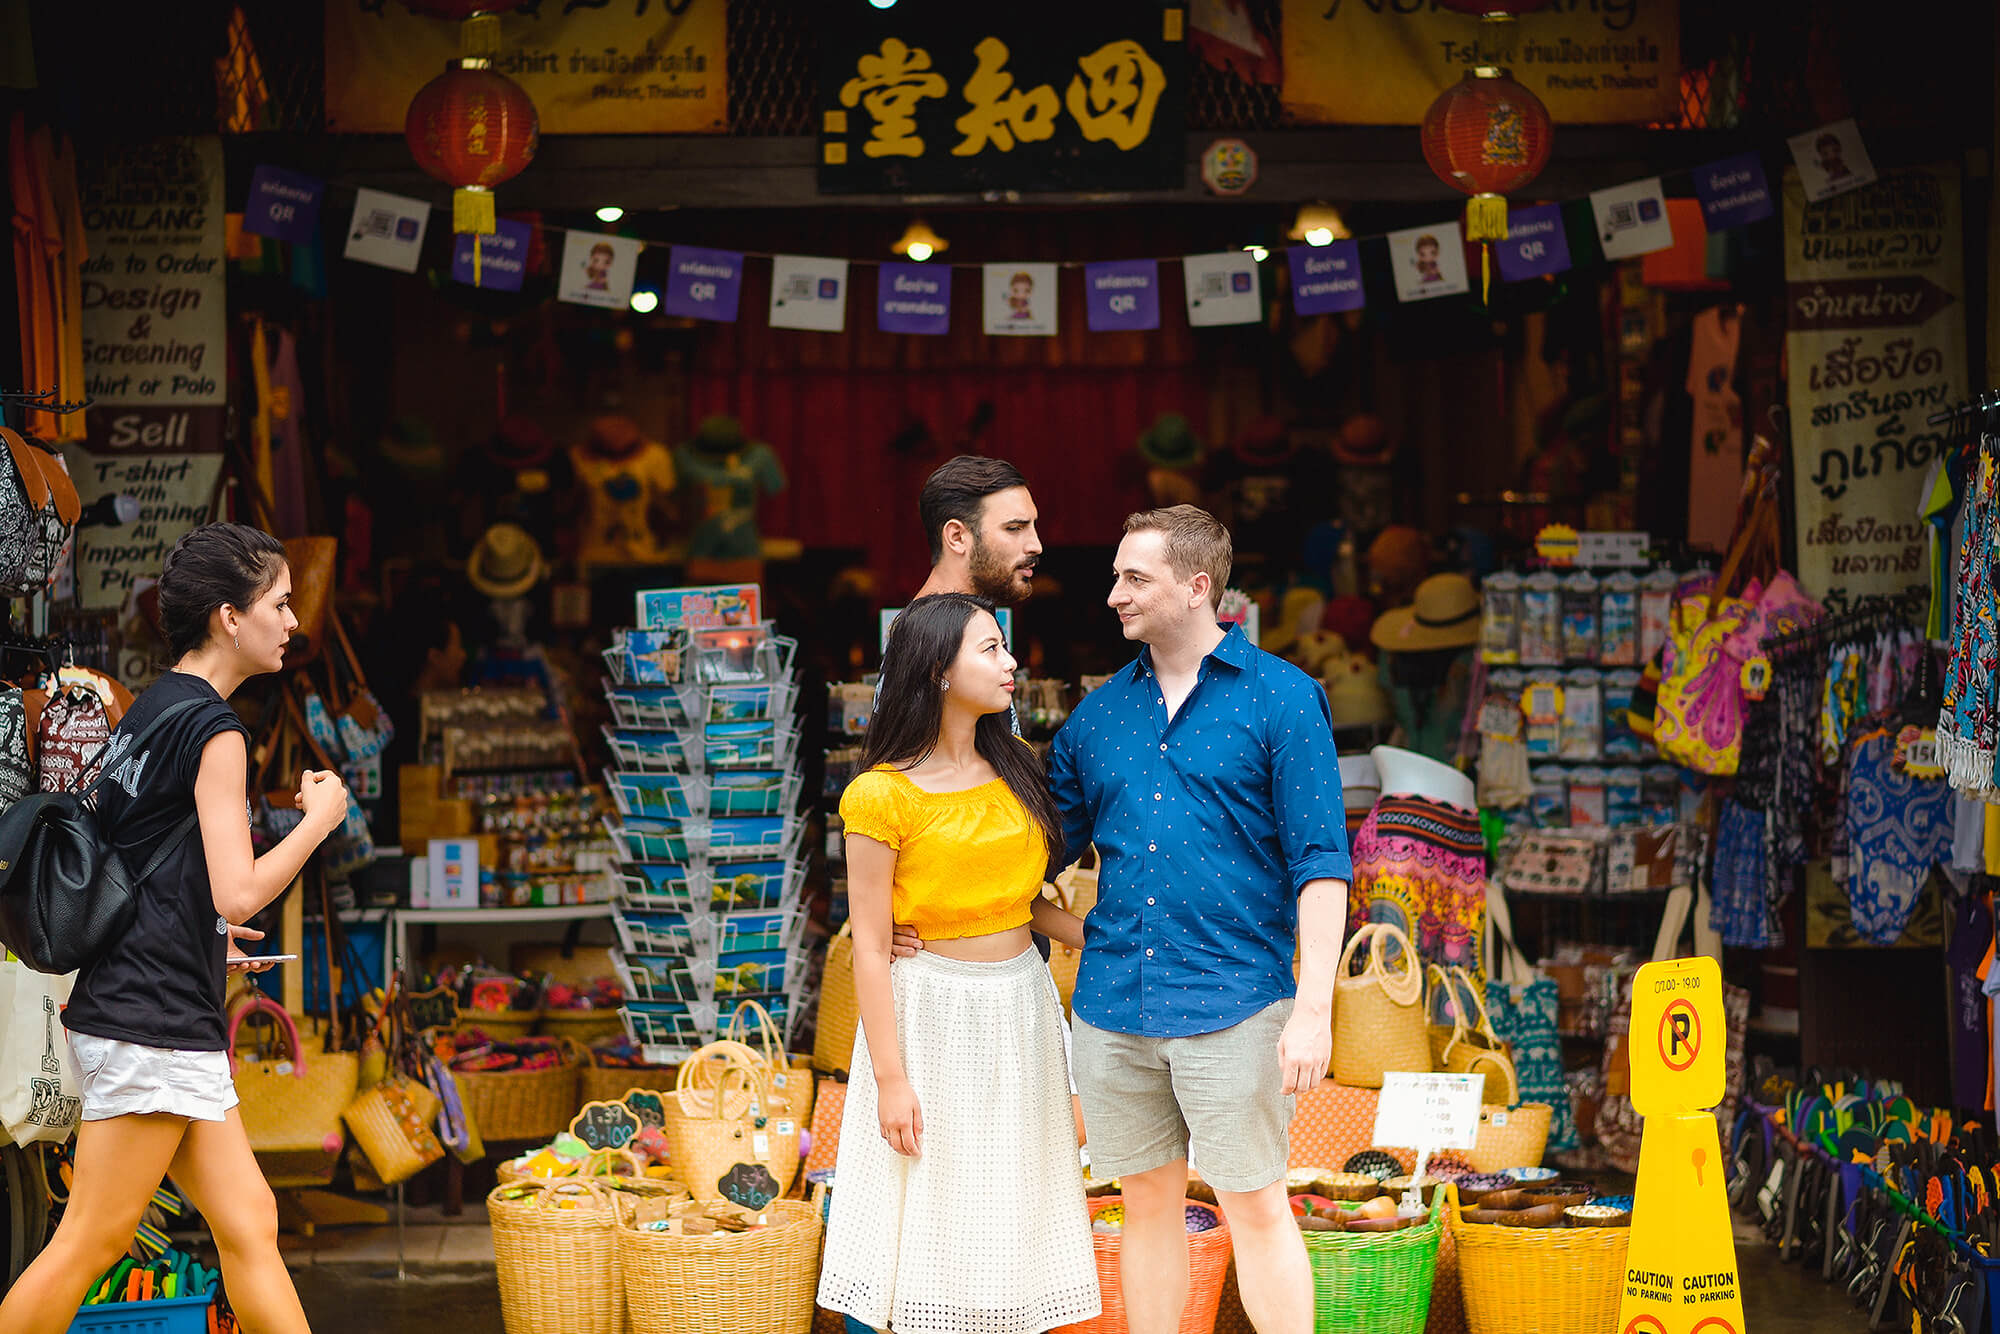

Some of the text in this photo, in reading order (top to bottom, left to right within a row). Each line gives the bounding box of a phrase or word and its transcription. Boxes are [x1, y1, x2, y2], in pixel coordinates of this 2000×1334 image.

[648, 84, 706, 98] Thailand
[1602, 74, 1659, 88] Thailand
[84, 208, 206, 232] ONLANG
[269, 202, 296, 224] QR
[1519, 241, 1547, 262] QR
[127, 253, 146, 274] to
[156, 253, 216, 274] Order
[82, 281, 202, 318] Design
[689, 282, 717, 301] QR
[1796, 283, 1922, 319] จำหน่าย
[1109, 294, 1136, 314] QR
[129, 314, 150, 339] &
[1810, 337, 1942, 391] เสื้อยืด
[140, 380, 160, 396] or
[171, 375, 215, 396] Polo
[1812, 384, 1948, 426] สกรีนลาย
[109, 413, 190, 448] Sell
[94, 457, 191, 484] T-shirt
[123, 484, 166, 502] With
[132, 525, 157, 540] All
[1831, 546, 1922, 574] หลากสี
[1628, 1269, 1673, 1289] CAUTION
[1683, 1272, 1734, 1290] CAUTION
[1627, 1287, 1673, 1303] NO PARKING
[1684, 1289, 1735, 1304] NO PARKING
